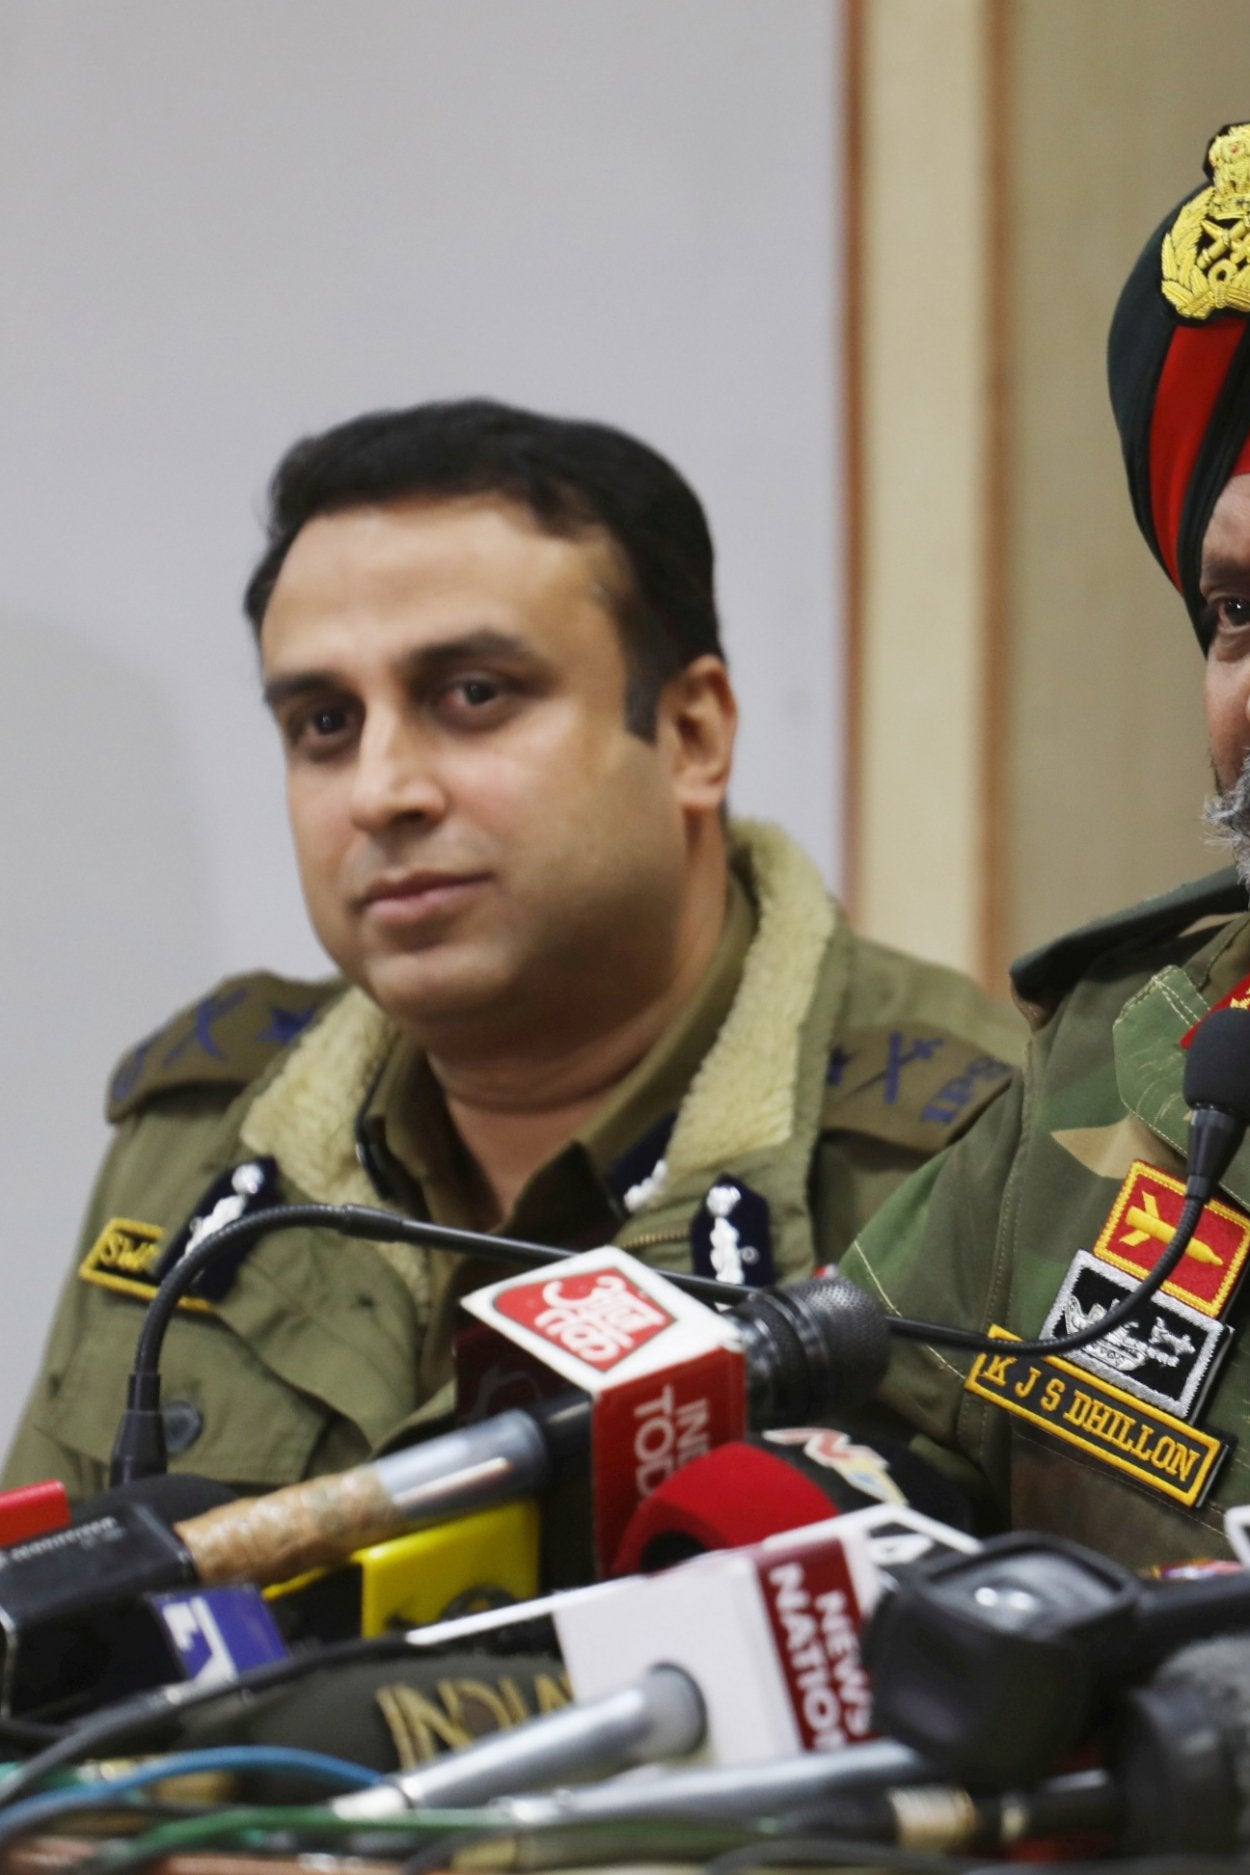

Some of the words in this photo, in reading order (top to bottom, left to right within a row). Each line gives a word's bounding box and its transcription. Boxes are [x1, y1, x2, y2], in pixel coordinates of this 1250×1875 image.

[981, 1354, 1018, 1387] K
[1014, 1366, 1042, 1399] J
[1040, 1378, 1066, 1412] S
[1062, 1388, 1200, 1482] DHILLON
[815, 1589, 872, 1737] NEWS
